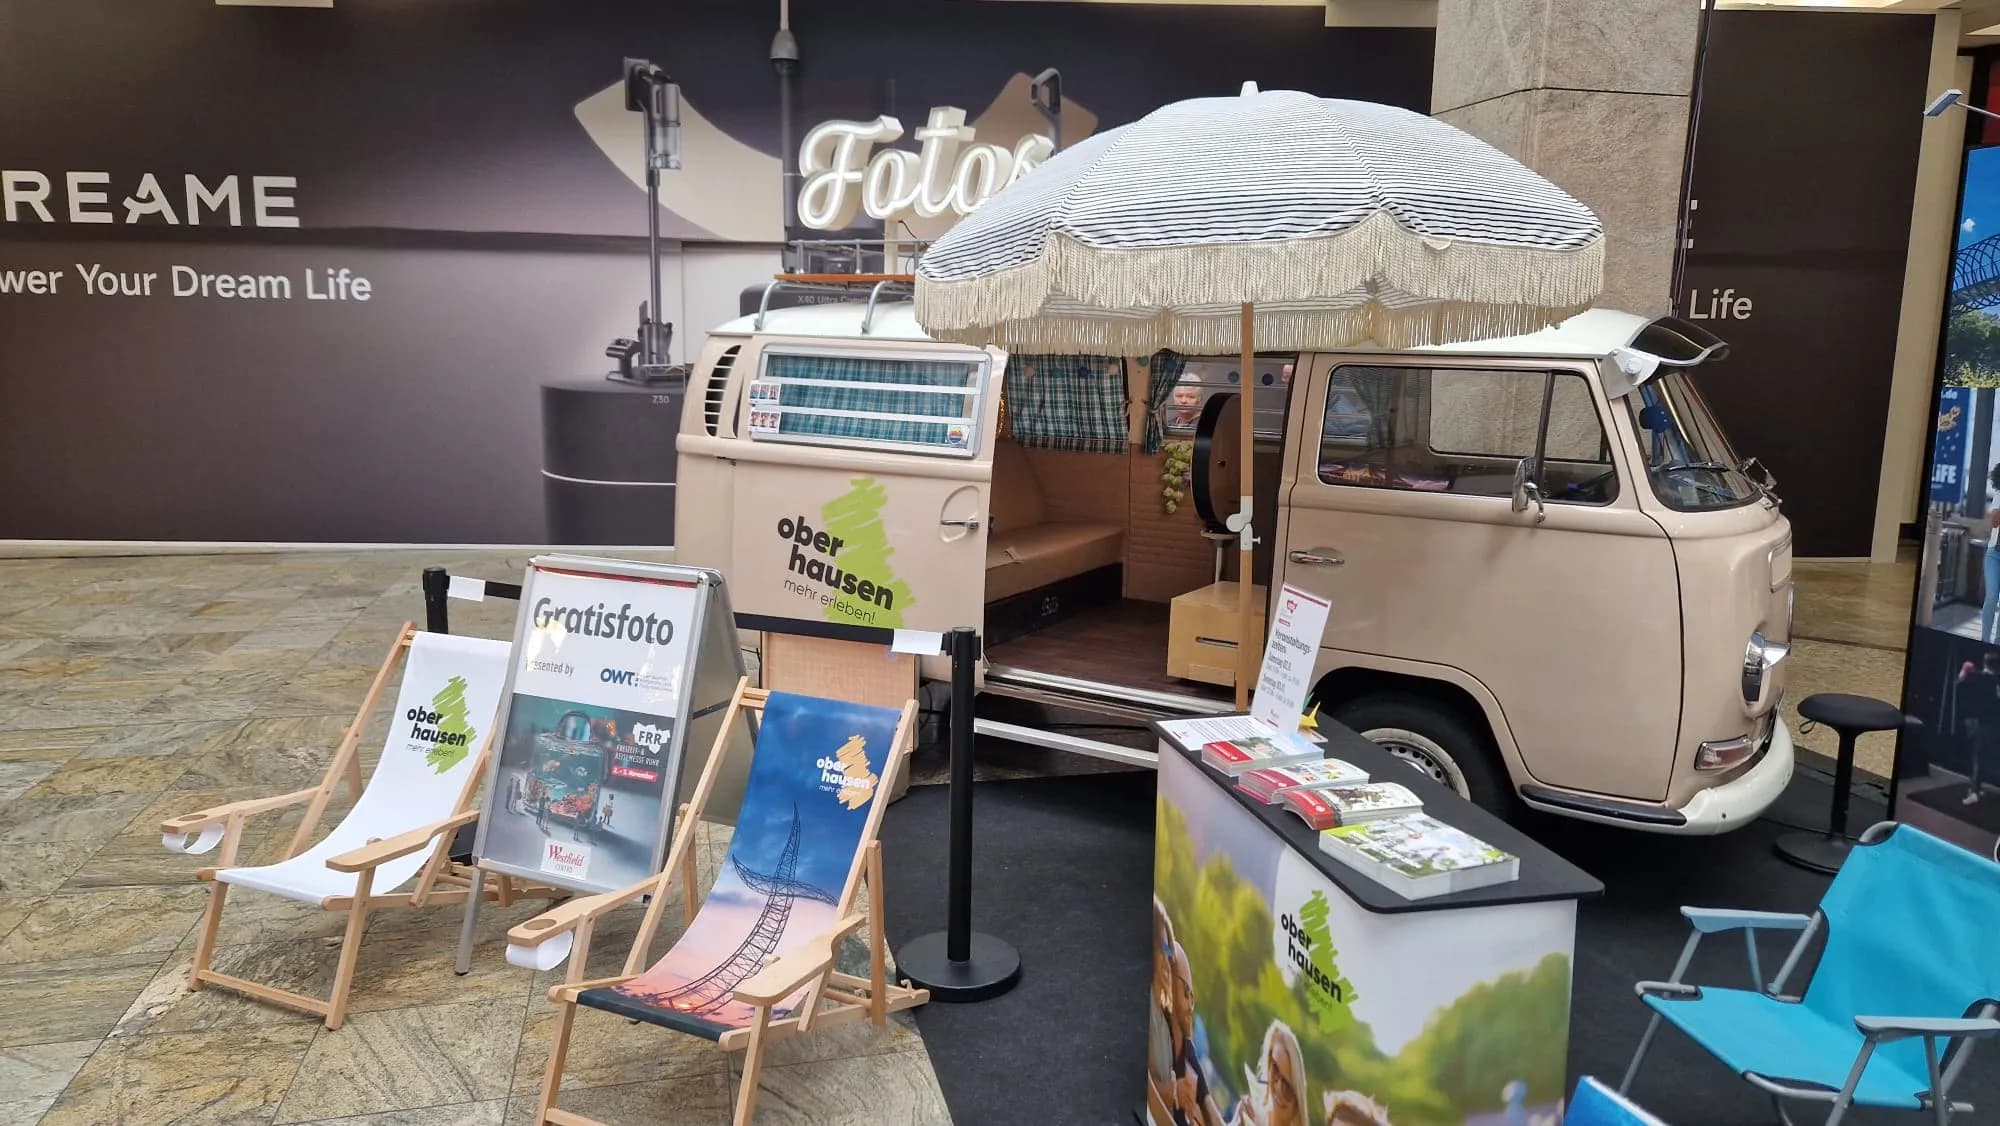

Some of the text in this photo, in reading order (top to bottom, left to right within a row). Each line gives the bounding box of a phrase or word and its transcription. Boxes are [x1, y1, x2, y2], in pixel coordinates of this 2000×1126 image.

[1, 170, 301, 228] REAME
[75, 263, 157, 296] Your
[170, 265, 292, 299] Dream
[304, 267, 373, 301] Life
[1689, 288, 1753, 320] Life
[777, 515, 845, 558] ober
[788, 544, 894, 611] hausen
[783, 578, 877, 625] mehr erleben!
[533, 597, 675, 646] Gratisfoto
[564, 663, 575, 677] by
[407, 705, 443, 725] ober
[410, 722, 467, 747] hausen
[638, 731, 662, 746] FRR
[816, 756, 847, 772] ober
[549, 844, 585, 867] Westfield
[1281, 913, 1312, 951] ober
[1288, 936, 1343, 1004] hausen
